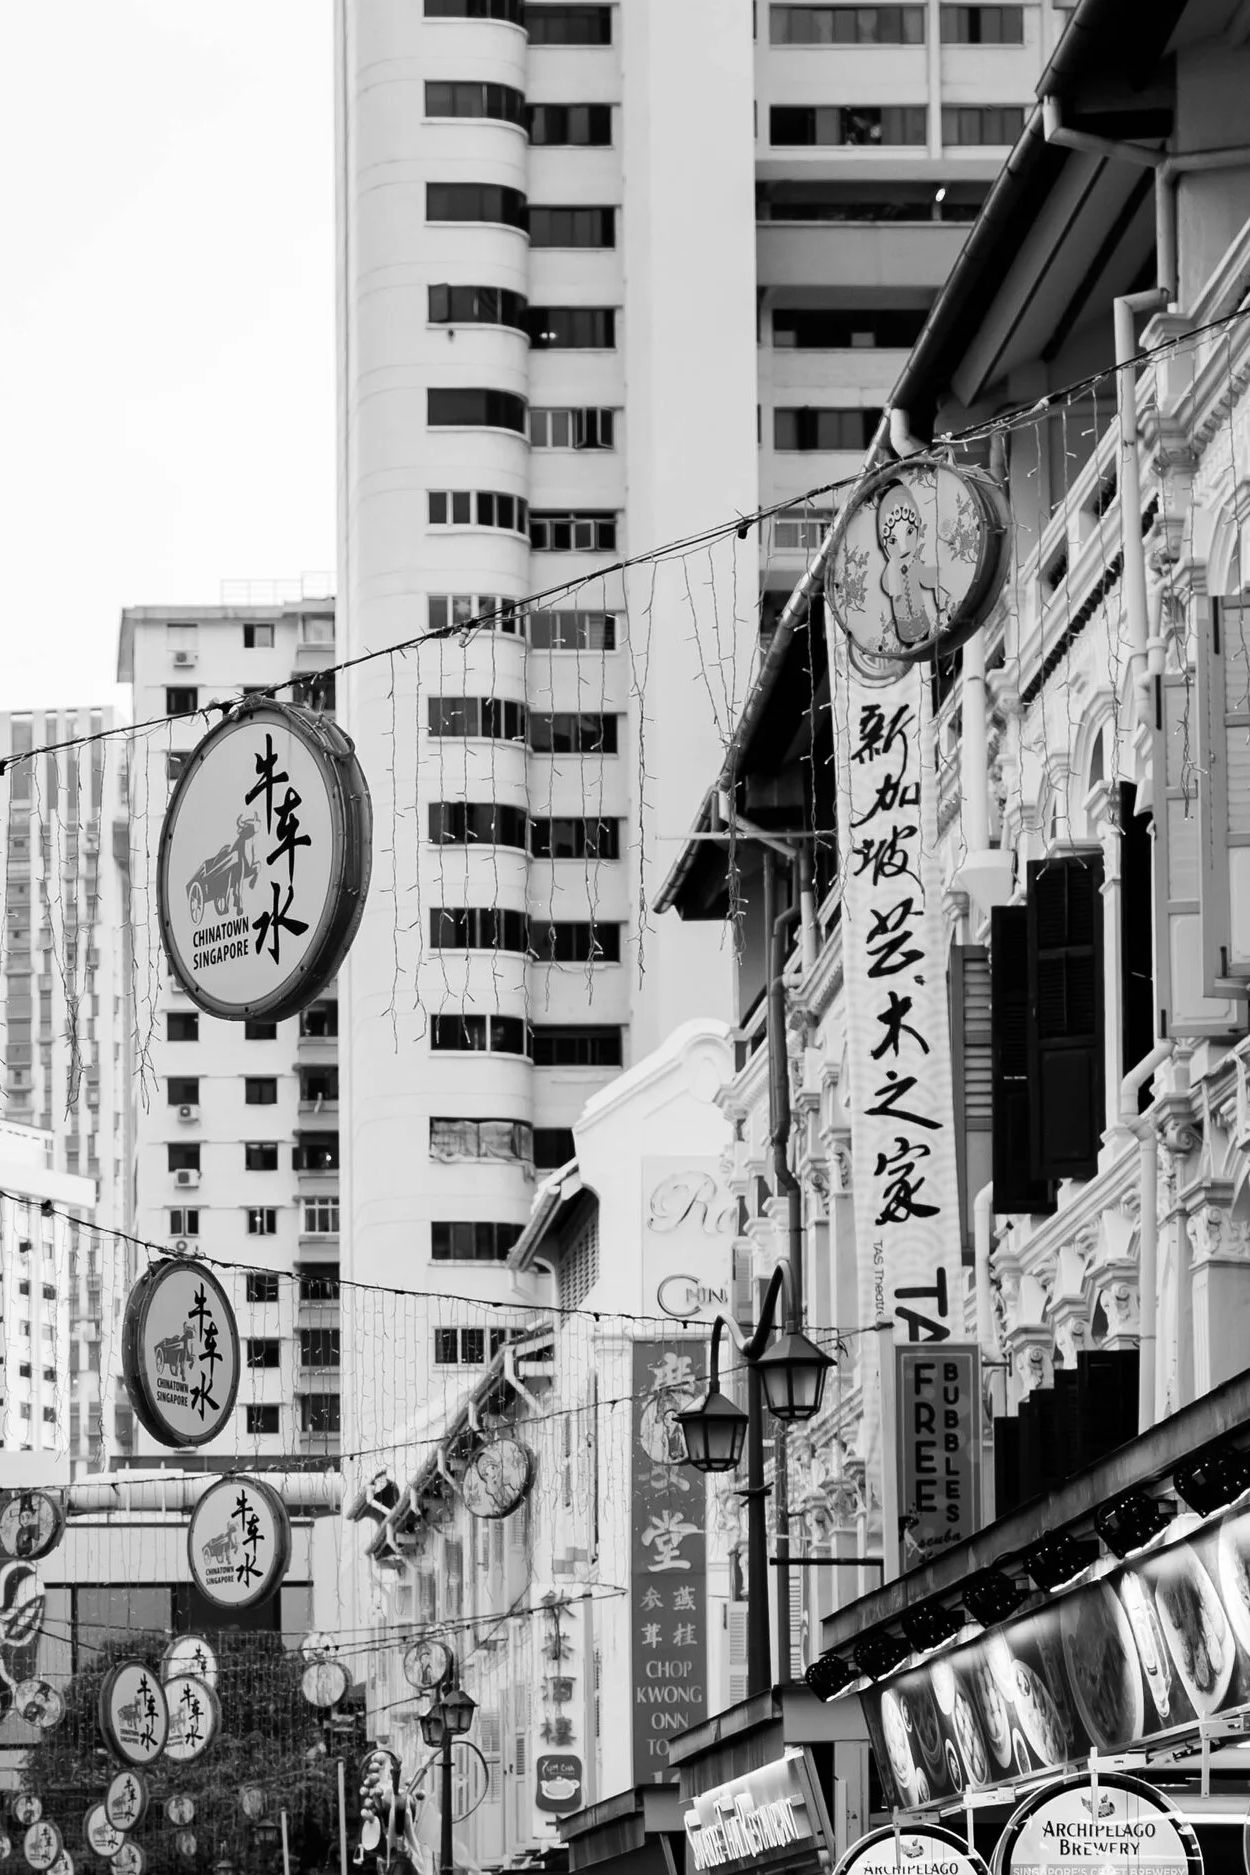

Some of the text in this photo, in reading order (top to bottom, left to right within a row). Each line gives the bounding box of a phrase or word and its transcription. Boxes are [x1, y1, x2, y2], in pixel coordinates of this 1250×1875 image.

[193, 916, 250, 948] CHINATOWN
[193, 939, 250, 970] SINGAPORE
[657, 1274, 728, 1317] CHIN
[894, 1267, 950, 1342] TA
[157, 1378, 189, 1394] CHINATOWN
[156, 1391, 189, 1407] SINGAPORE
[914, 1363, 937, 1512] FREE
[943, 1363, 960, 1523] BUBBLES
[646, 1660, 692, 1678] CHOP
[636, 1686, 702, 1704] KWONG
[652, 1712, 688, 1730] ONN
[646, 1739, 669, 1756] TO
[1042, 1821, 1156, 1838] ARCHIPELAGO
[1059, 1839, 1140, 1855] BREWERY
[864, 1861, 959, 1875] ARCHIPELAGO
